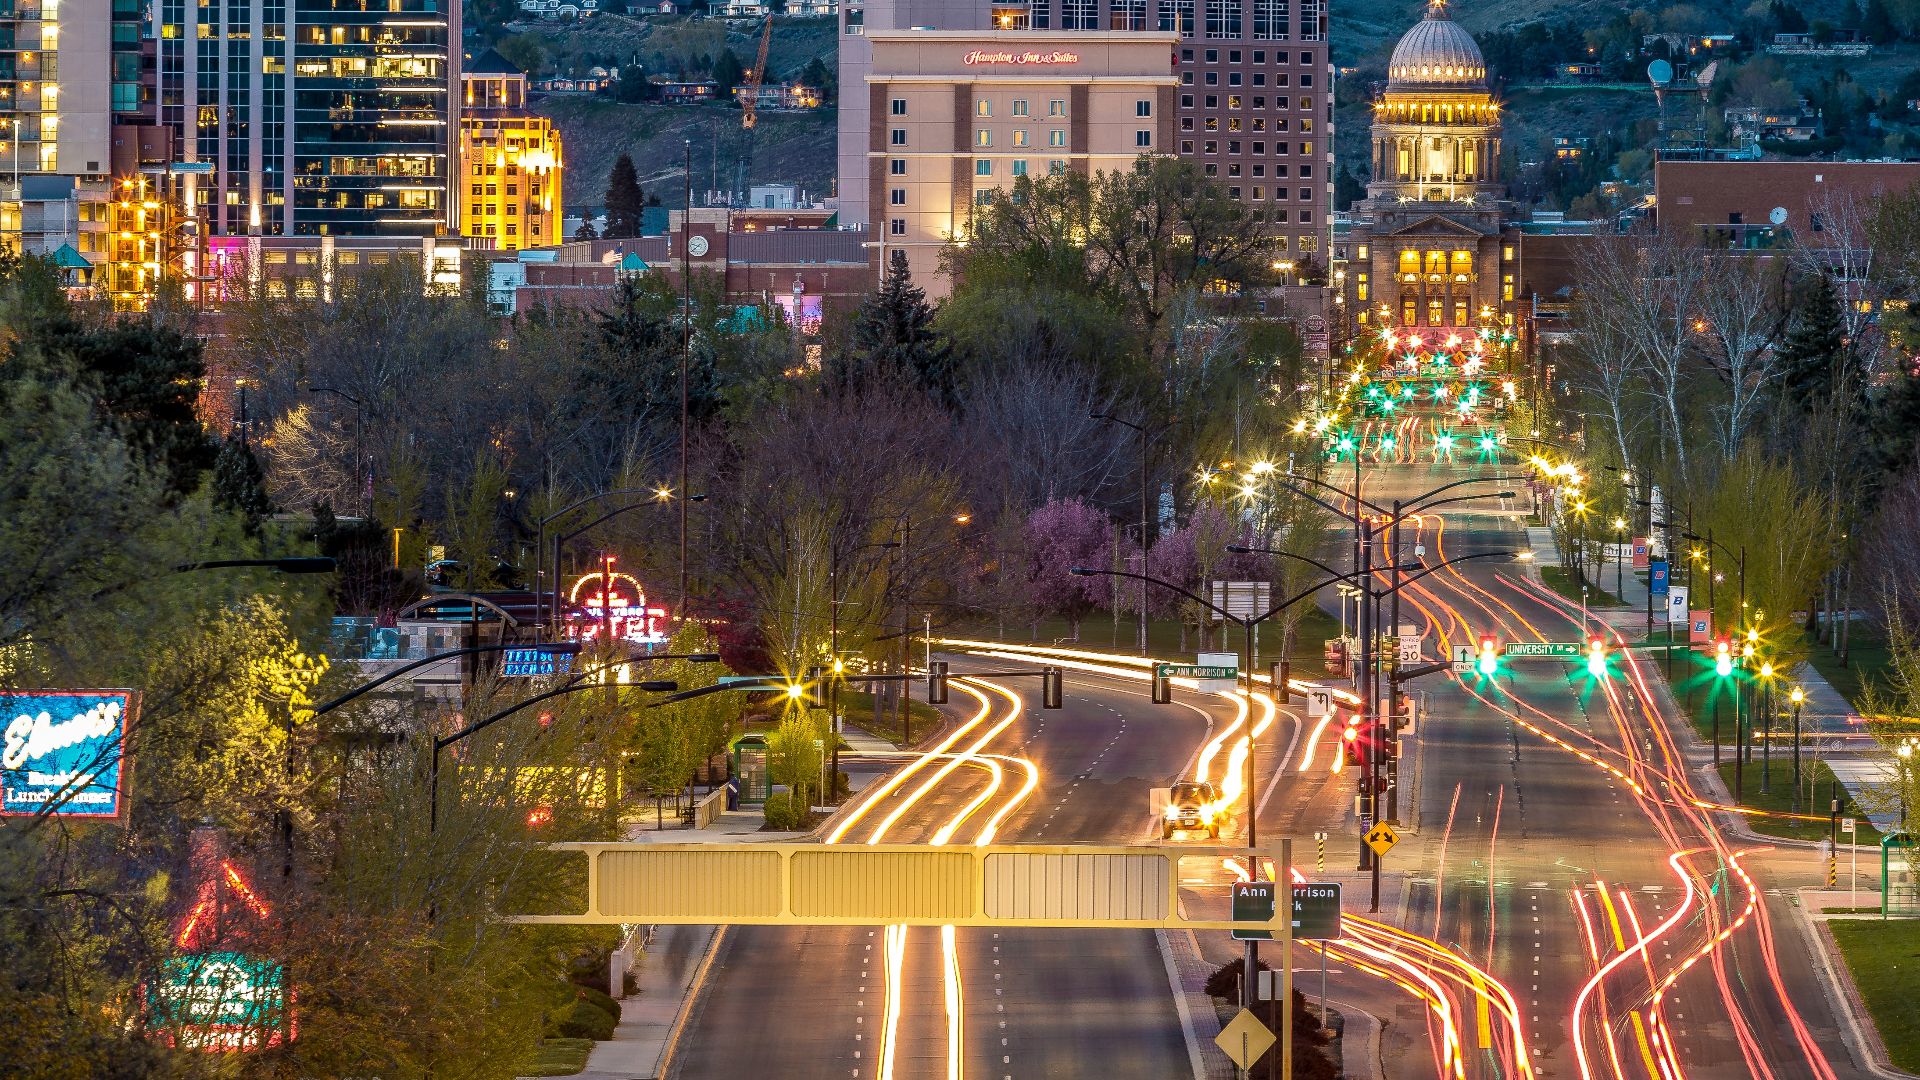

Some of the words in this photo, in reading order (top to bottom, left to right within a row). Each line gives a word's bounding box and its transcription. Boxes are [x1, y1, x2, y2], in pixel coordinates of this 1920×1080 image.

[963, 50, 1016, 64] Hampton
[1017, 51, 1043, 64] Inn
[1049, 51, 1078, 63] Suites
[1673, 596, 1683, 605] B
[1402, 650, 1419, 661] 30
[1176, 667, 1190, 676] ANN
[1192, 667, 1226, 677] MORRISON
[1239, 886, 1267, 897] Ann
[1291, 887, 1335, 898] rrison
